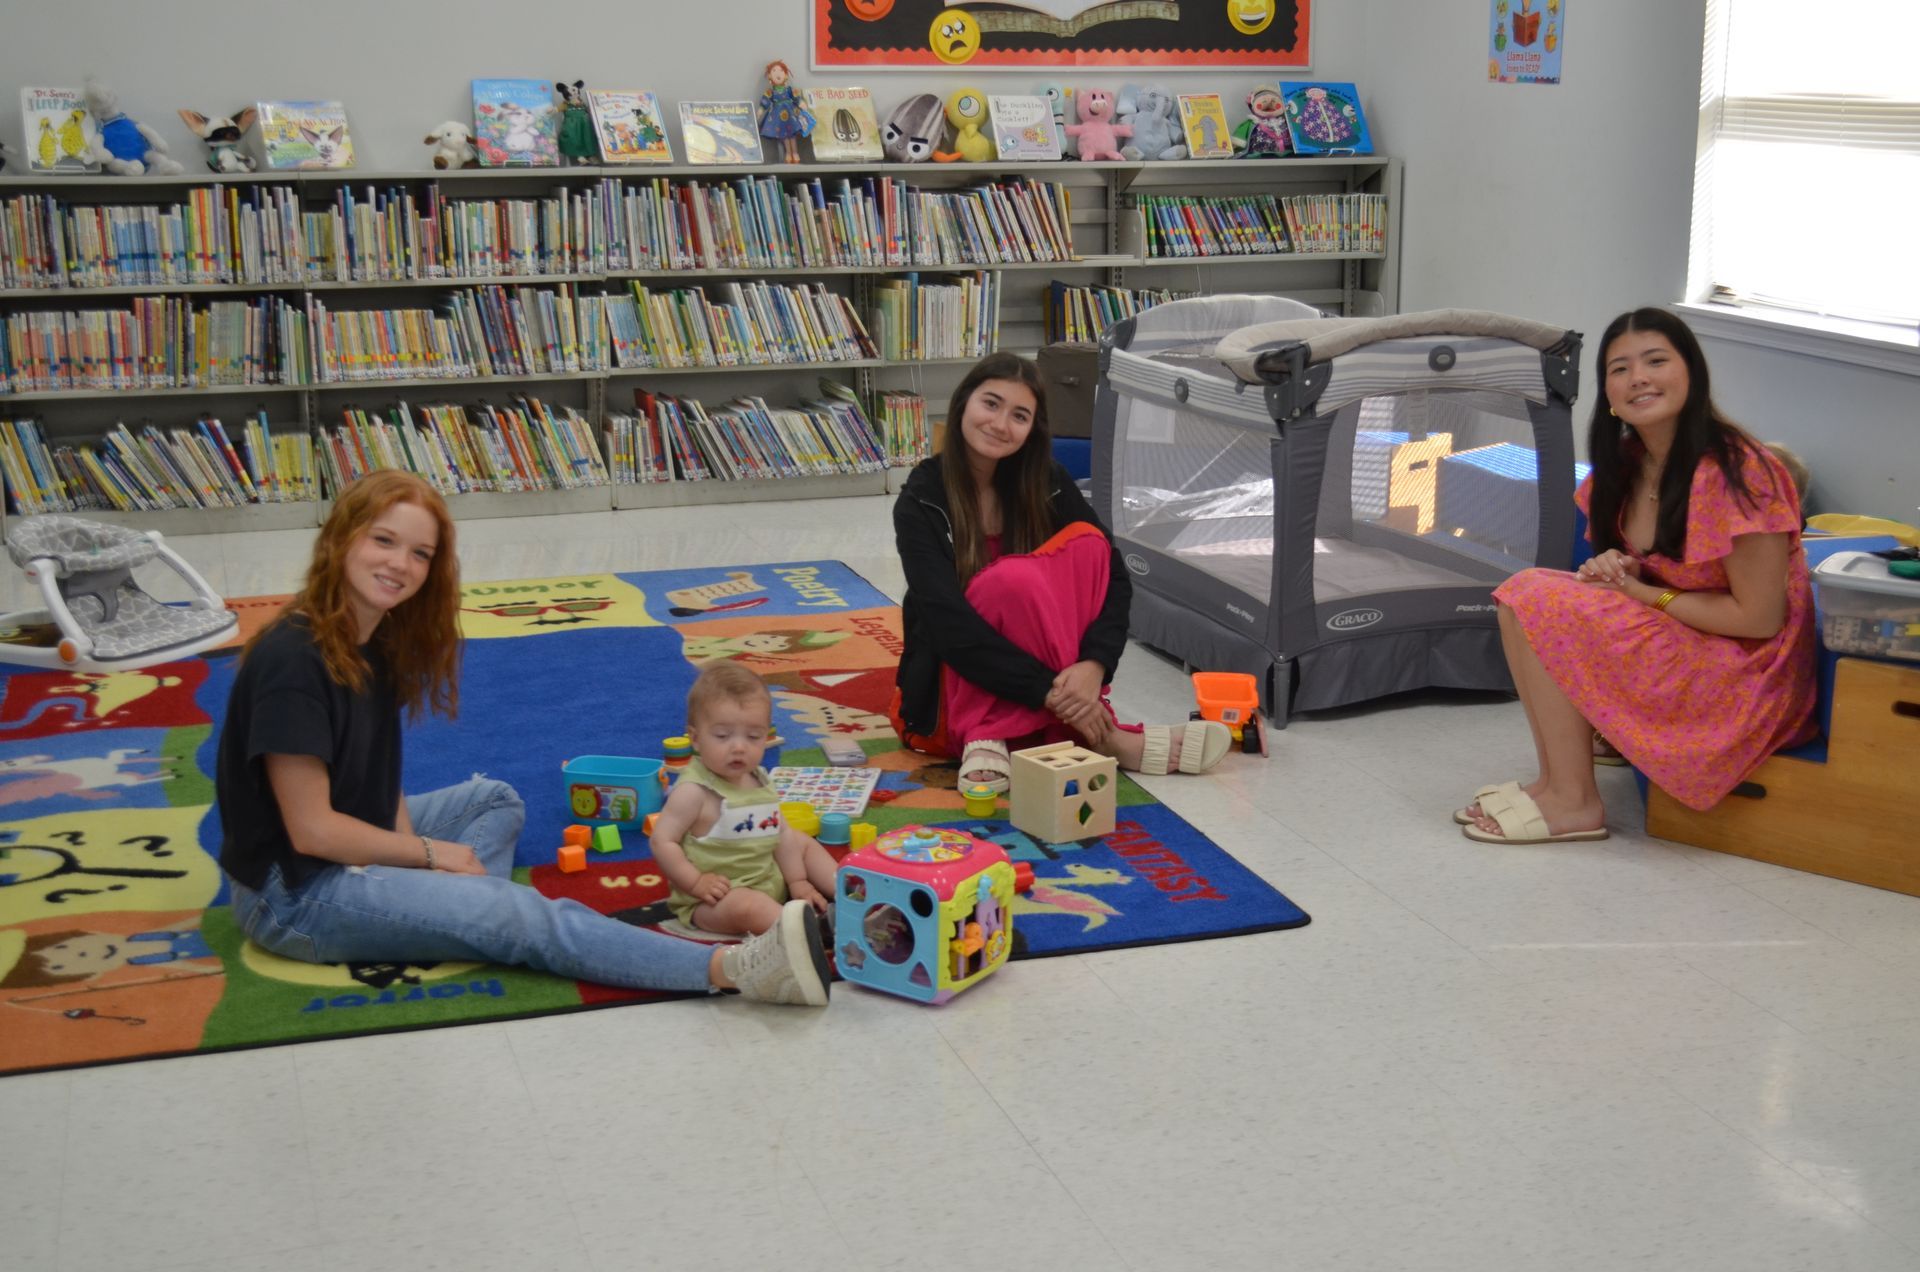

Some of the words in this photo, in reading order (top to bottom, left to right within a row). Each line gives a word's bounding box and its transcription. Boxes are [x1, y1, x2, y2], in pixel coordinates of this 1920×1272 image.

[1507, 51, 1525, 61] Llama
[1525, 51, 1541, 61] Llama
[827, 90, 845, 100] BAD
[847, 89, 869, 100] SEED
[462, 580, 603, 597] umor
[773, 566, 850, 607] Poetry
[1334, 611, 1379, 627] GRACO
[1101, 820, 1230, 902] FANTASY
[301, 978, 506, 1014] horror
